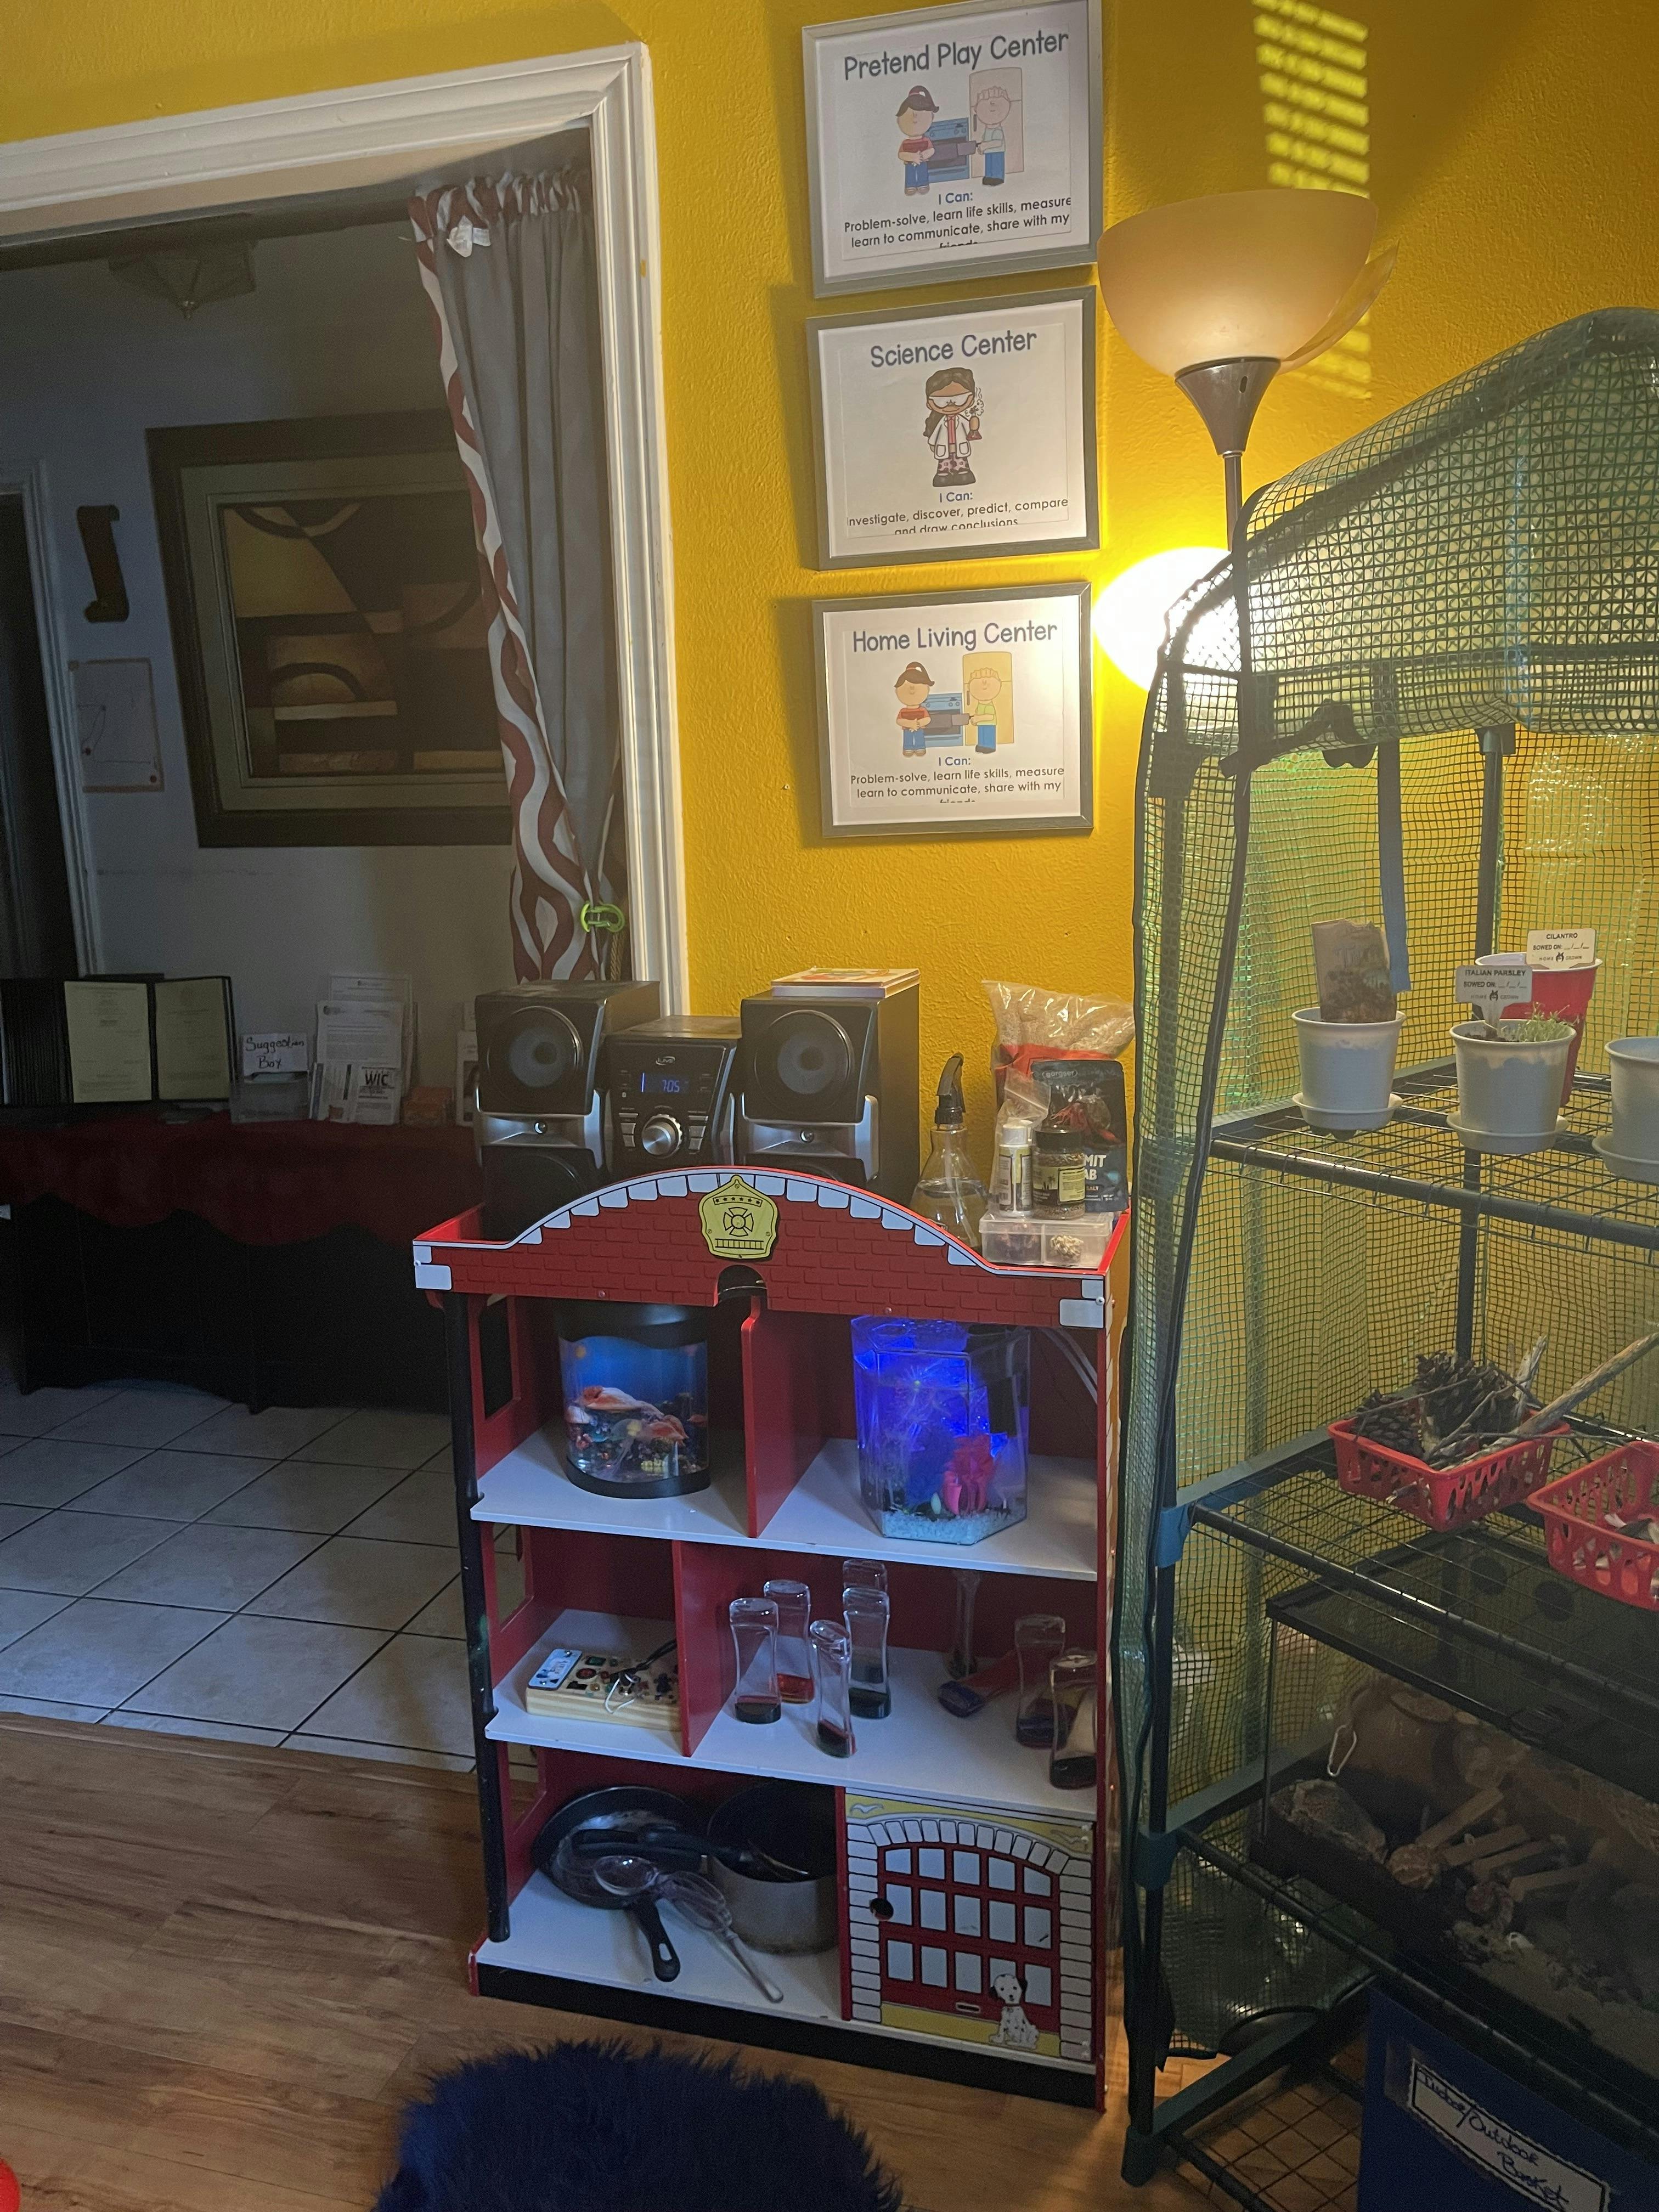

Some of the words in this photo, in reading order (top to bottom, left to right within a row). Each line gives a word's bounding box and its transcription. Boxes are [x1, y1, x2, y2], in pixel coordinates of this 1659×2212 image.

[844, 44, 929, 80] Pretend
[938, 42, 981, 70] Play
[991, 30, 1069, 58] Center
[938, 194, 942, 205] I
[946, 192, 973, 203] Can:
[844, 214, 929, 233] Problem-solve,
[933, 209, 962, 222] learn
[966, 206, 983, 218] life
[987, 202, 1017, 216] skills,
[1021, 198, 1071, 211] measure
[851, 235, 880, 248] learn
[884, 233, 894, 244] to
[898, 224, 983, 242] communicate,
[988, 219, 1019, 234] share
[1024, 215, 1048, 228] with
[1051, 215, 1070, 227] my
[871, 341, 953, 368] Science
[962, 330, 1037, 357] Center
[940, 493, 943, 503] I
[946, 492, 973, 502] Can:
[913, 505, 963, 521] discover,
[967, 502, 1011, 518] predict,
[1015, 498, 1068, 512] compare
[853, 630, 910, 652] Home
[918, 628, 976, 650] Living
[984, 620, 1057, 643] Center
[938, 757, 941, 766] I
[945, 756, 971, 766] Can:
[851, 772, 930, 785] Problem-solve,
[934, 770, 961, 781] learn
[965, 769, 980, 779] life
[984, 768, 1012, 778] skills,
[1016, 767, 1064, 777] measure
[857, 788, 884, 798] learn
[887, 787, 897, 797] to
[901, 783, 980, 797] communicate,
[984, 782, 1014, 793] share
[1018, 781, 1040, 791] with
[1044, 781, 1061, 792] my
[246, 1036, 304, 1054] Suggestion
[1085, 1154, 1107, 1167] MIT
[1085, 1169, 1097, 1180] AB
